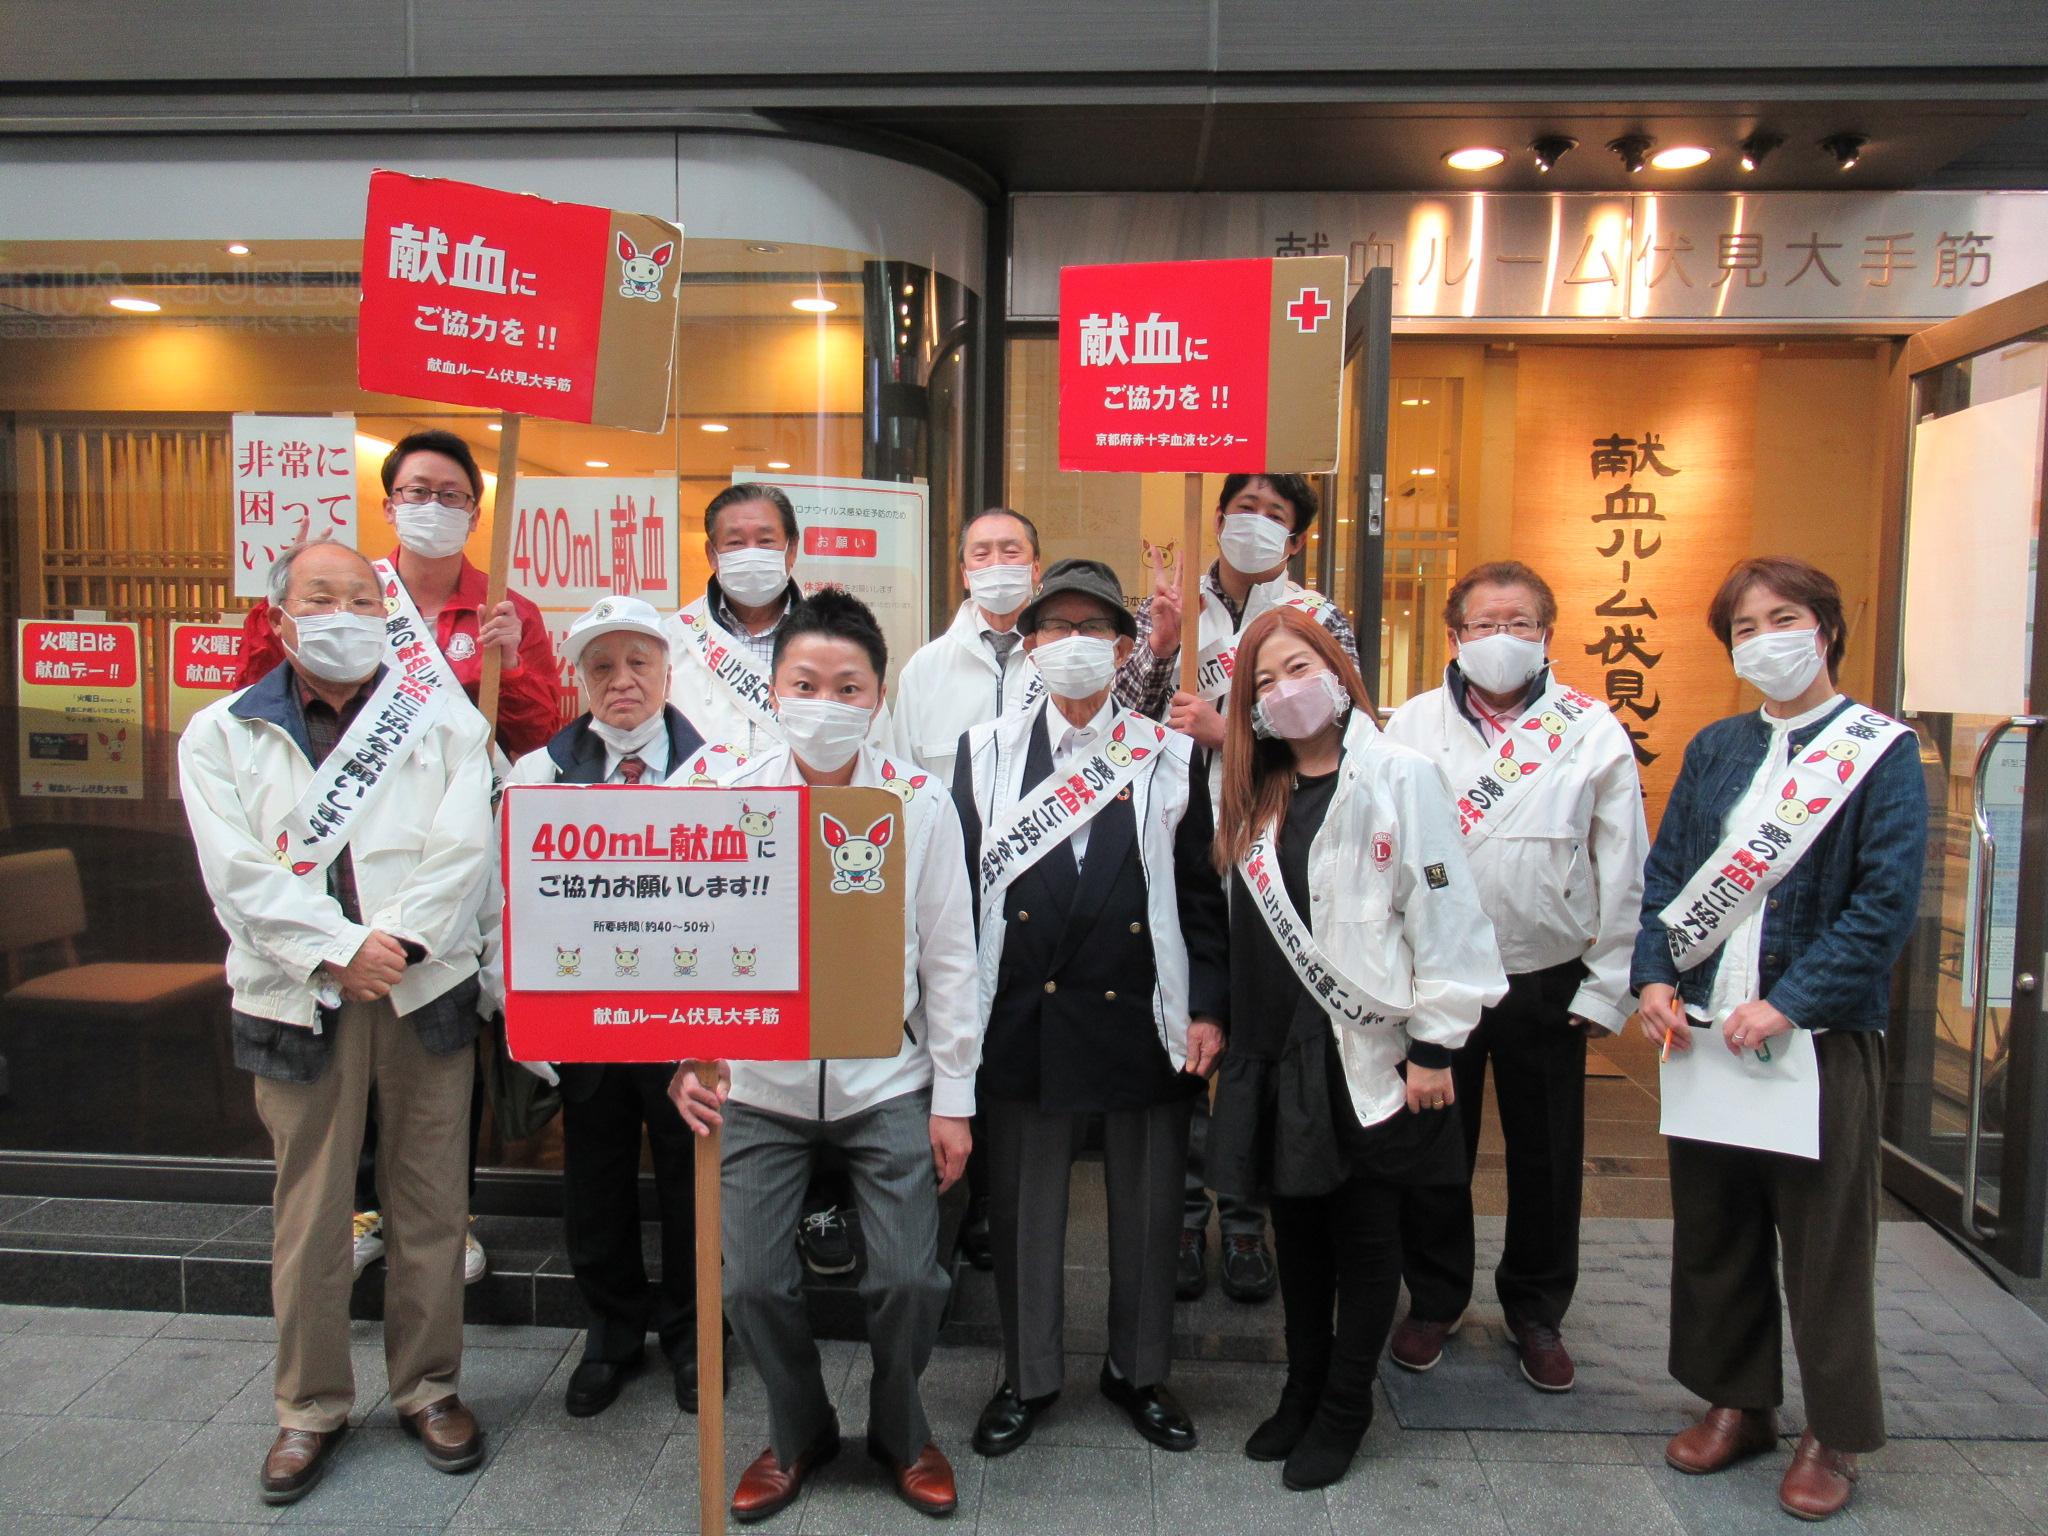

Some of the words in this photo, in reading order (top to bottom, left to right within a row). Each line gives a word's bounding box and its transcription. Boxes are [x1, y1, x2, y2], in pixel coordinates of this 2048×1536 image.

[388, 223, 537, 296] 献血に
[1080, 313, 1209, 366] 献血に
[427, 357, 572, 392] 献血ルーム伏見大手筋
[1095, 432, 1248, 447] 京都府赤十字血液センター
[238, 440, 349, 478] 非常に
[240, 490, 351, 526] 困って
[793, 505, 907, 520] ロナウイルス感染症予防のため
[513, 494, 667, 596] 400mL献血
[39, 631, 117, 652] 火曜日は
[593, 1007, 780, 1026] 献血ルーム伏見大手筋
